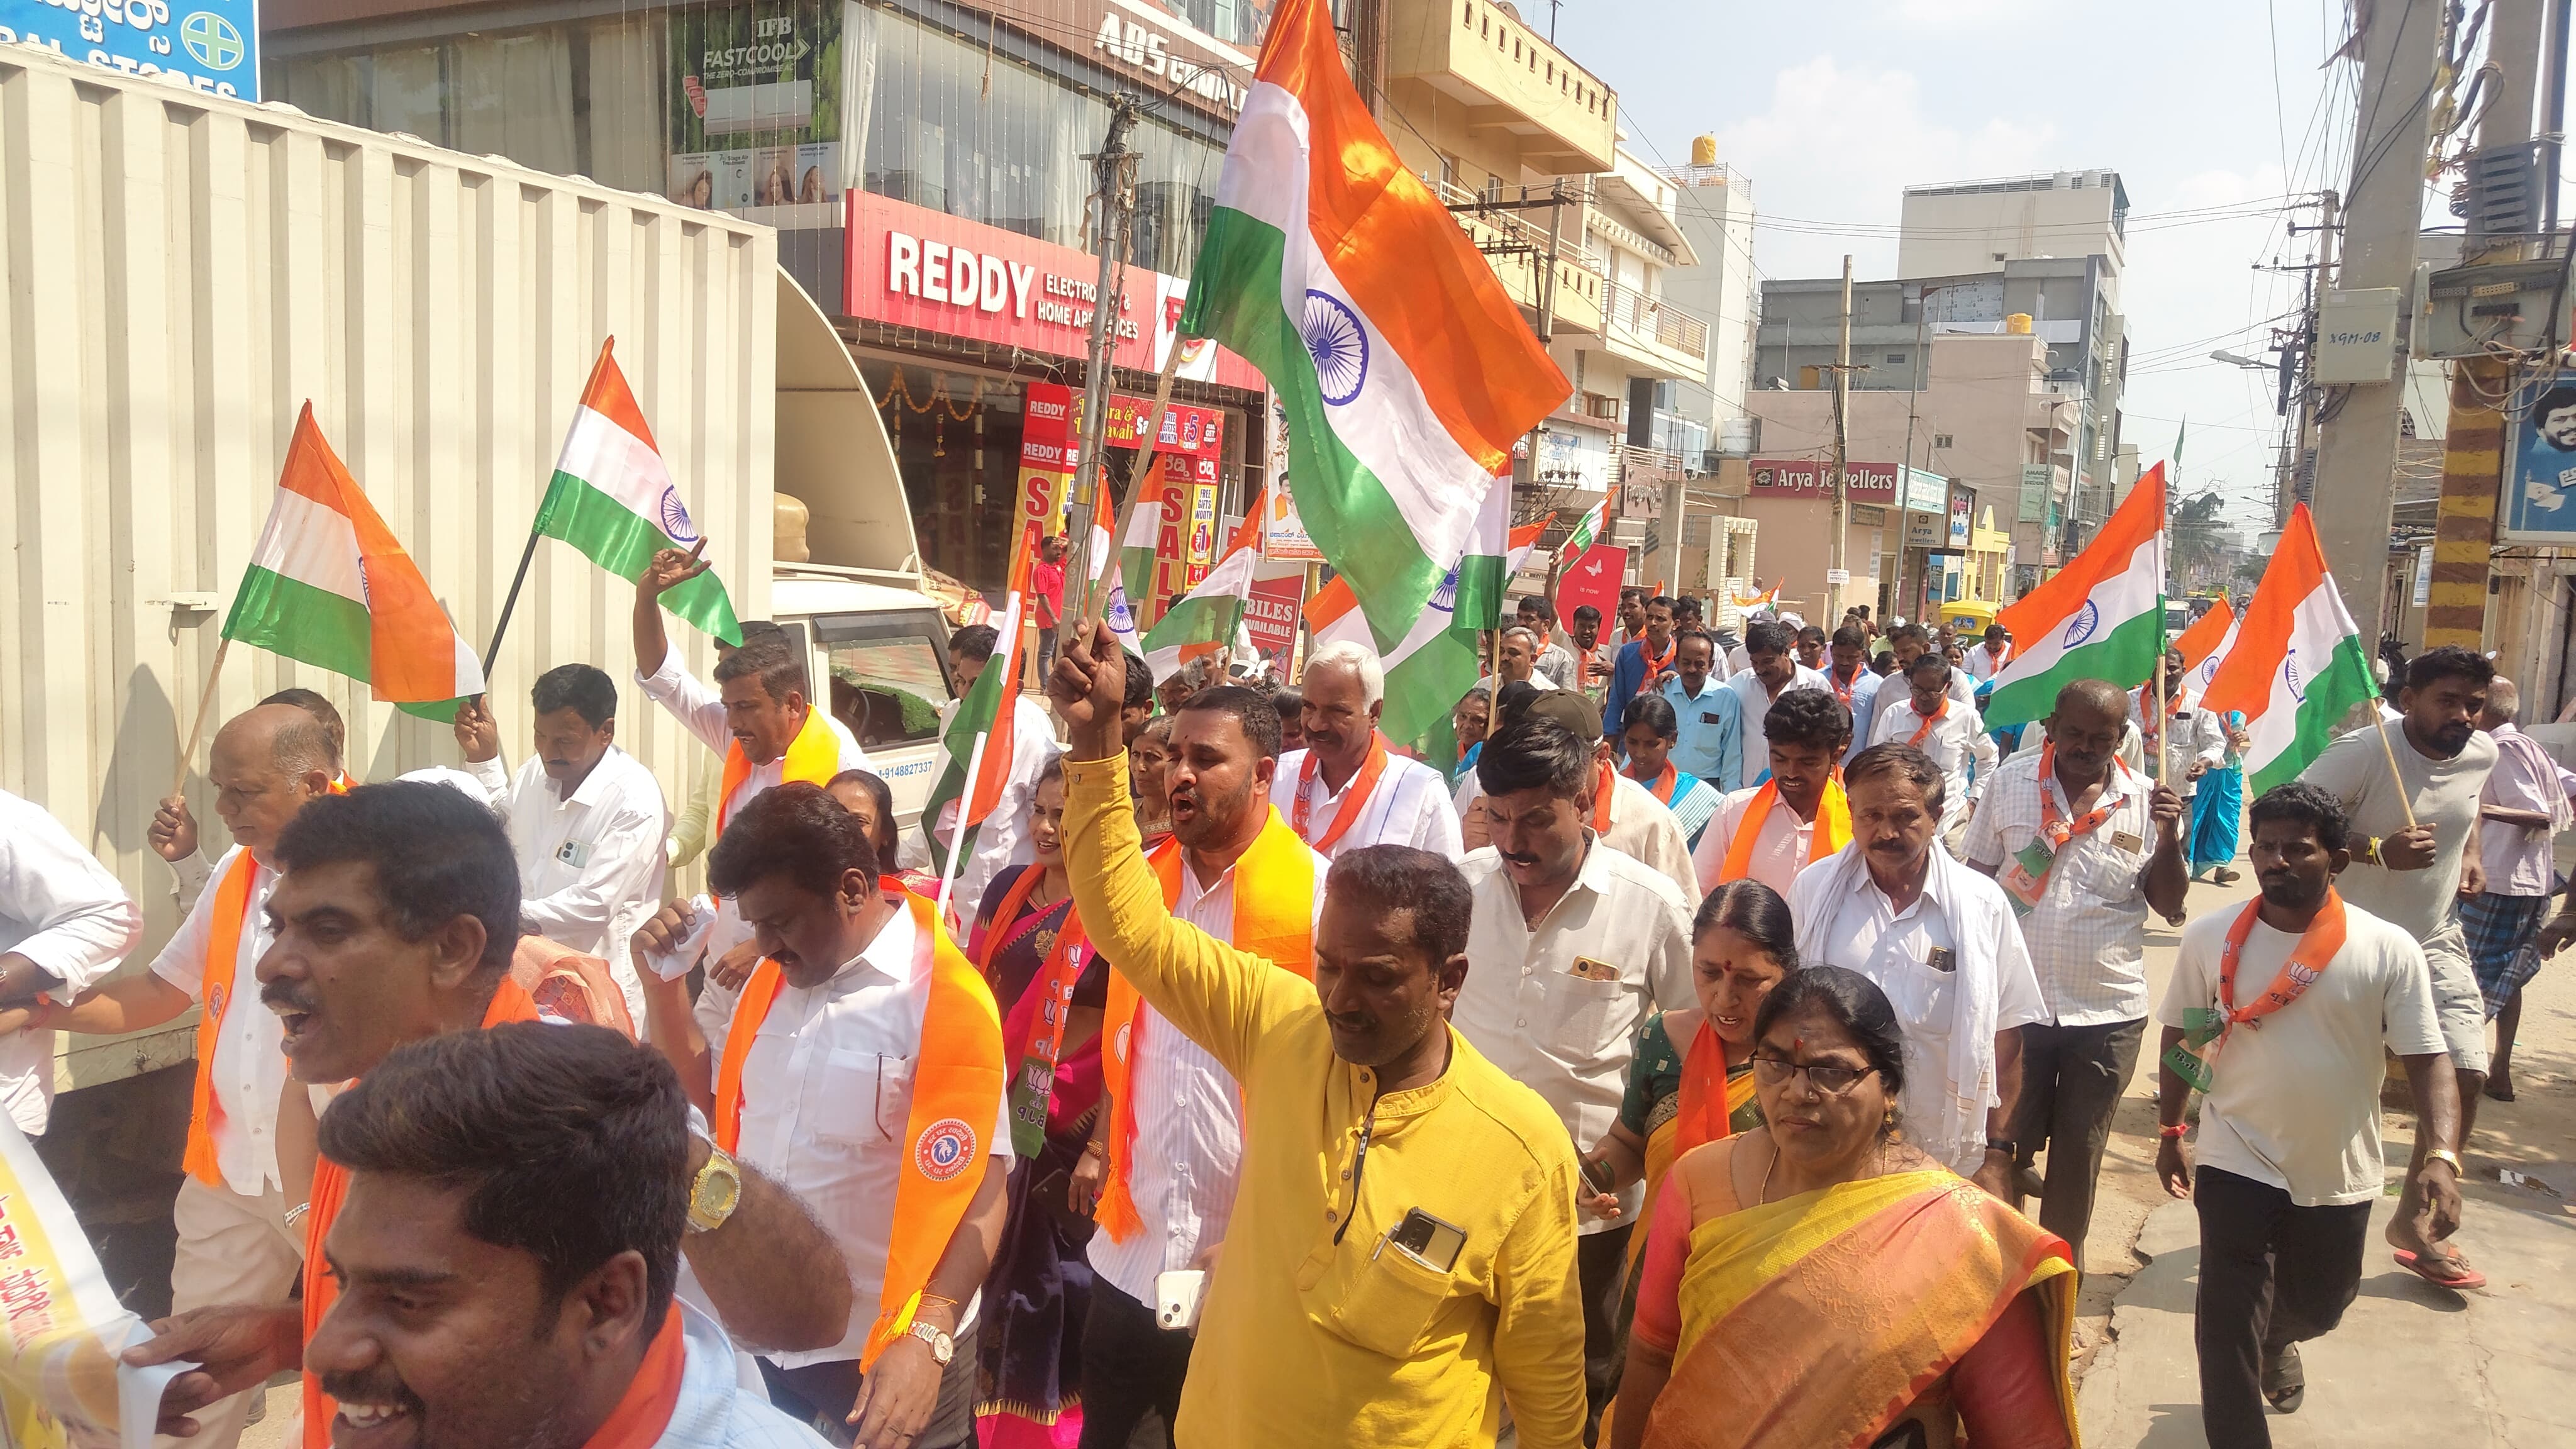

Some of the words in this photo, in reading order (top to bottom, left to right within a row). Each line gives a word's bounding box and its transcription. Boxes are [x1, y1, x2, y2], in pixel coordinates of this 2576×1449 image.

[757, 16, 792, 38] IFB
[1094, 11, 1169, 76] ABS
[703, 42, 797, 69] FASTCOOL
[703, 72, 716, 80] THE
[717, 64, 784, 79] ZERO-COMPROMISE
[887, 230, 1036, 318] REDDY
[1123, 293, 1131, 311] &
[1038, 301, 1071, 325] HOME
[1030, 401, 1066, 416] REDDY
[1165, 412, 1176, 422] FREE
[1162, 423, 1176, 433] GIFTS
[1159, 431, 1177, 444] WORTH
[1023, 442, 1062, 460] REDDY
[1777, 469, 1813, 492] Arya
[1819, 469, 1894, 491] Jeellers
[1200, 489, 1211, 499] FREE
[1197, 499, 1211, 509] GIFTS
[1195, 510, 1213, 520] WORTH
[1911, 526, 1932, 535] Arya
[1585, 587, 1600, 595] now
